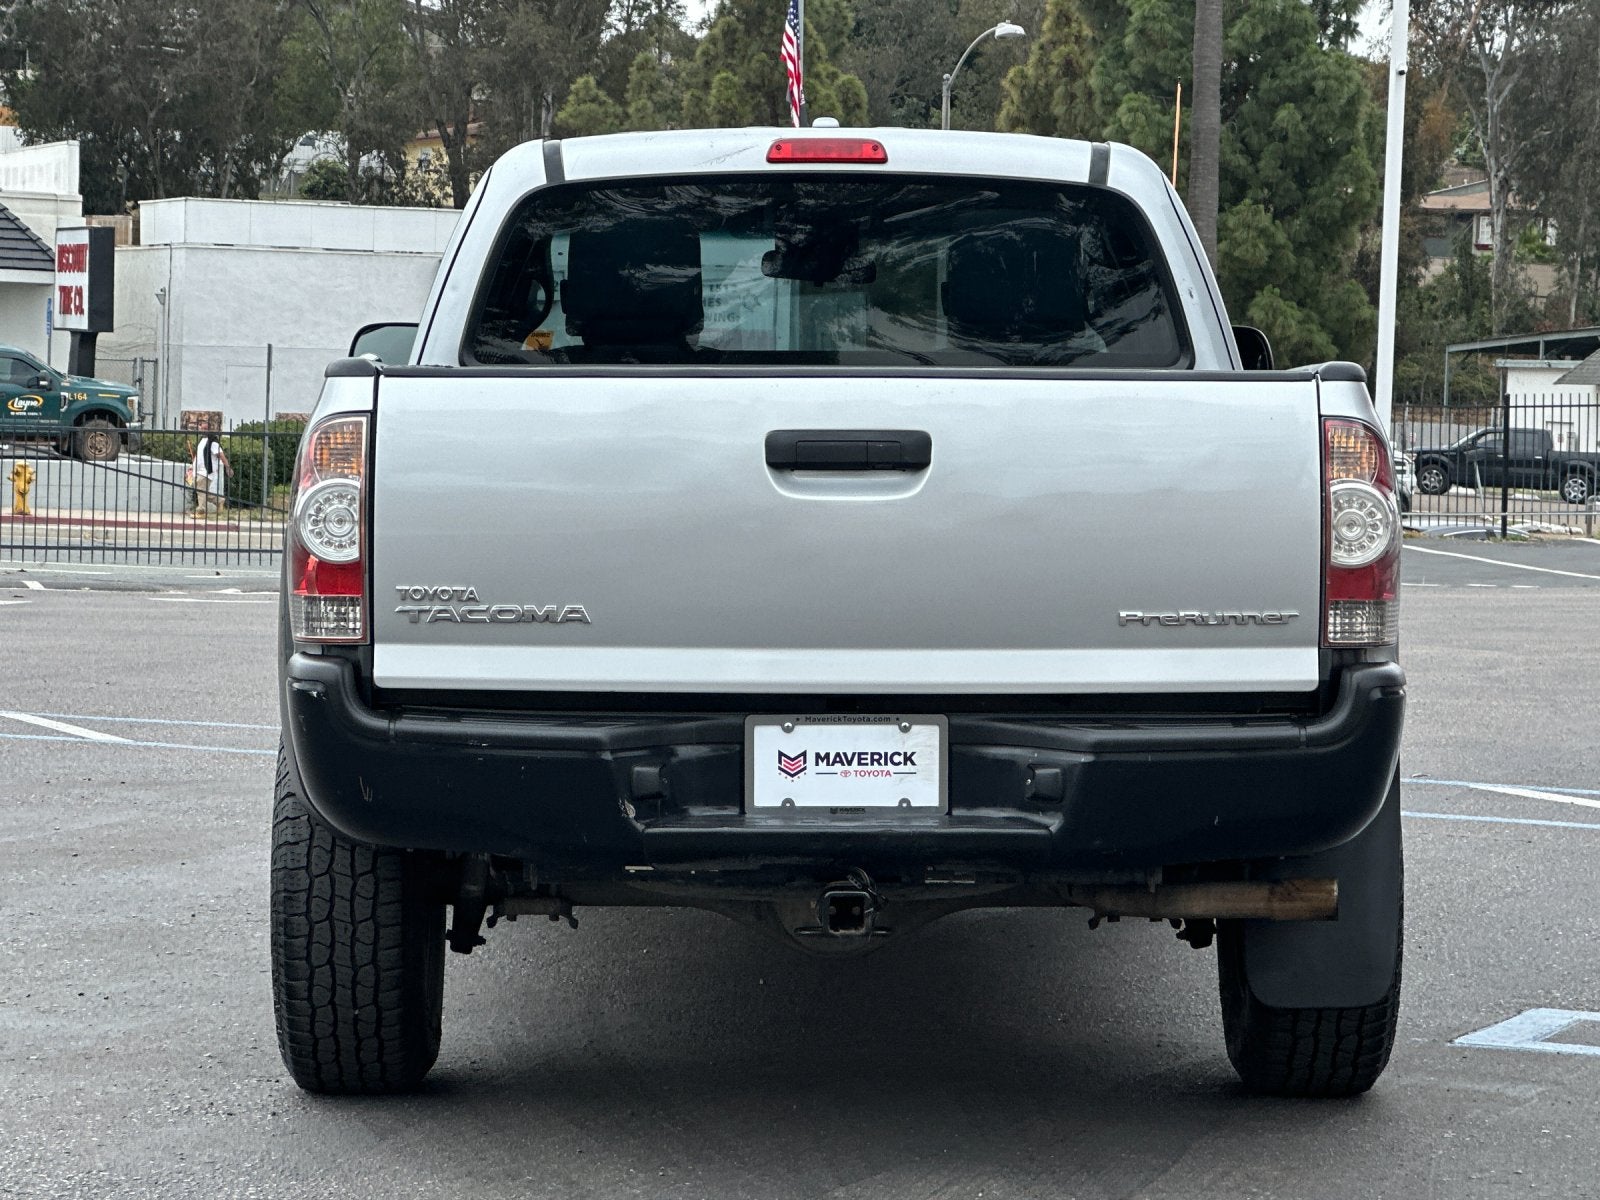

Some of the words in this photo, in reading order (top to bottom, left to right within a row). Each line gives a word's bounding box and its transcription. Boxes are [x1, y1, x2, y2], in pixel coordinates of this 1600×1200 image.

[395, 585, 479, 601] TOYOTA
[395, 604, 591, 623] TACOMA
[1118, 611, 1300, 626] PreRunner
[804, 715, 891, 723] MaverickToyota.com
[814, 751, 917, 767] MAVERICK
[853, 769, 892, 778] TOYOTA
